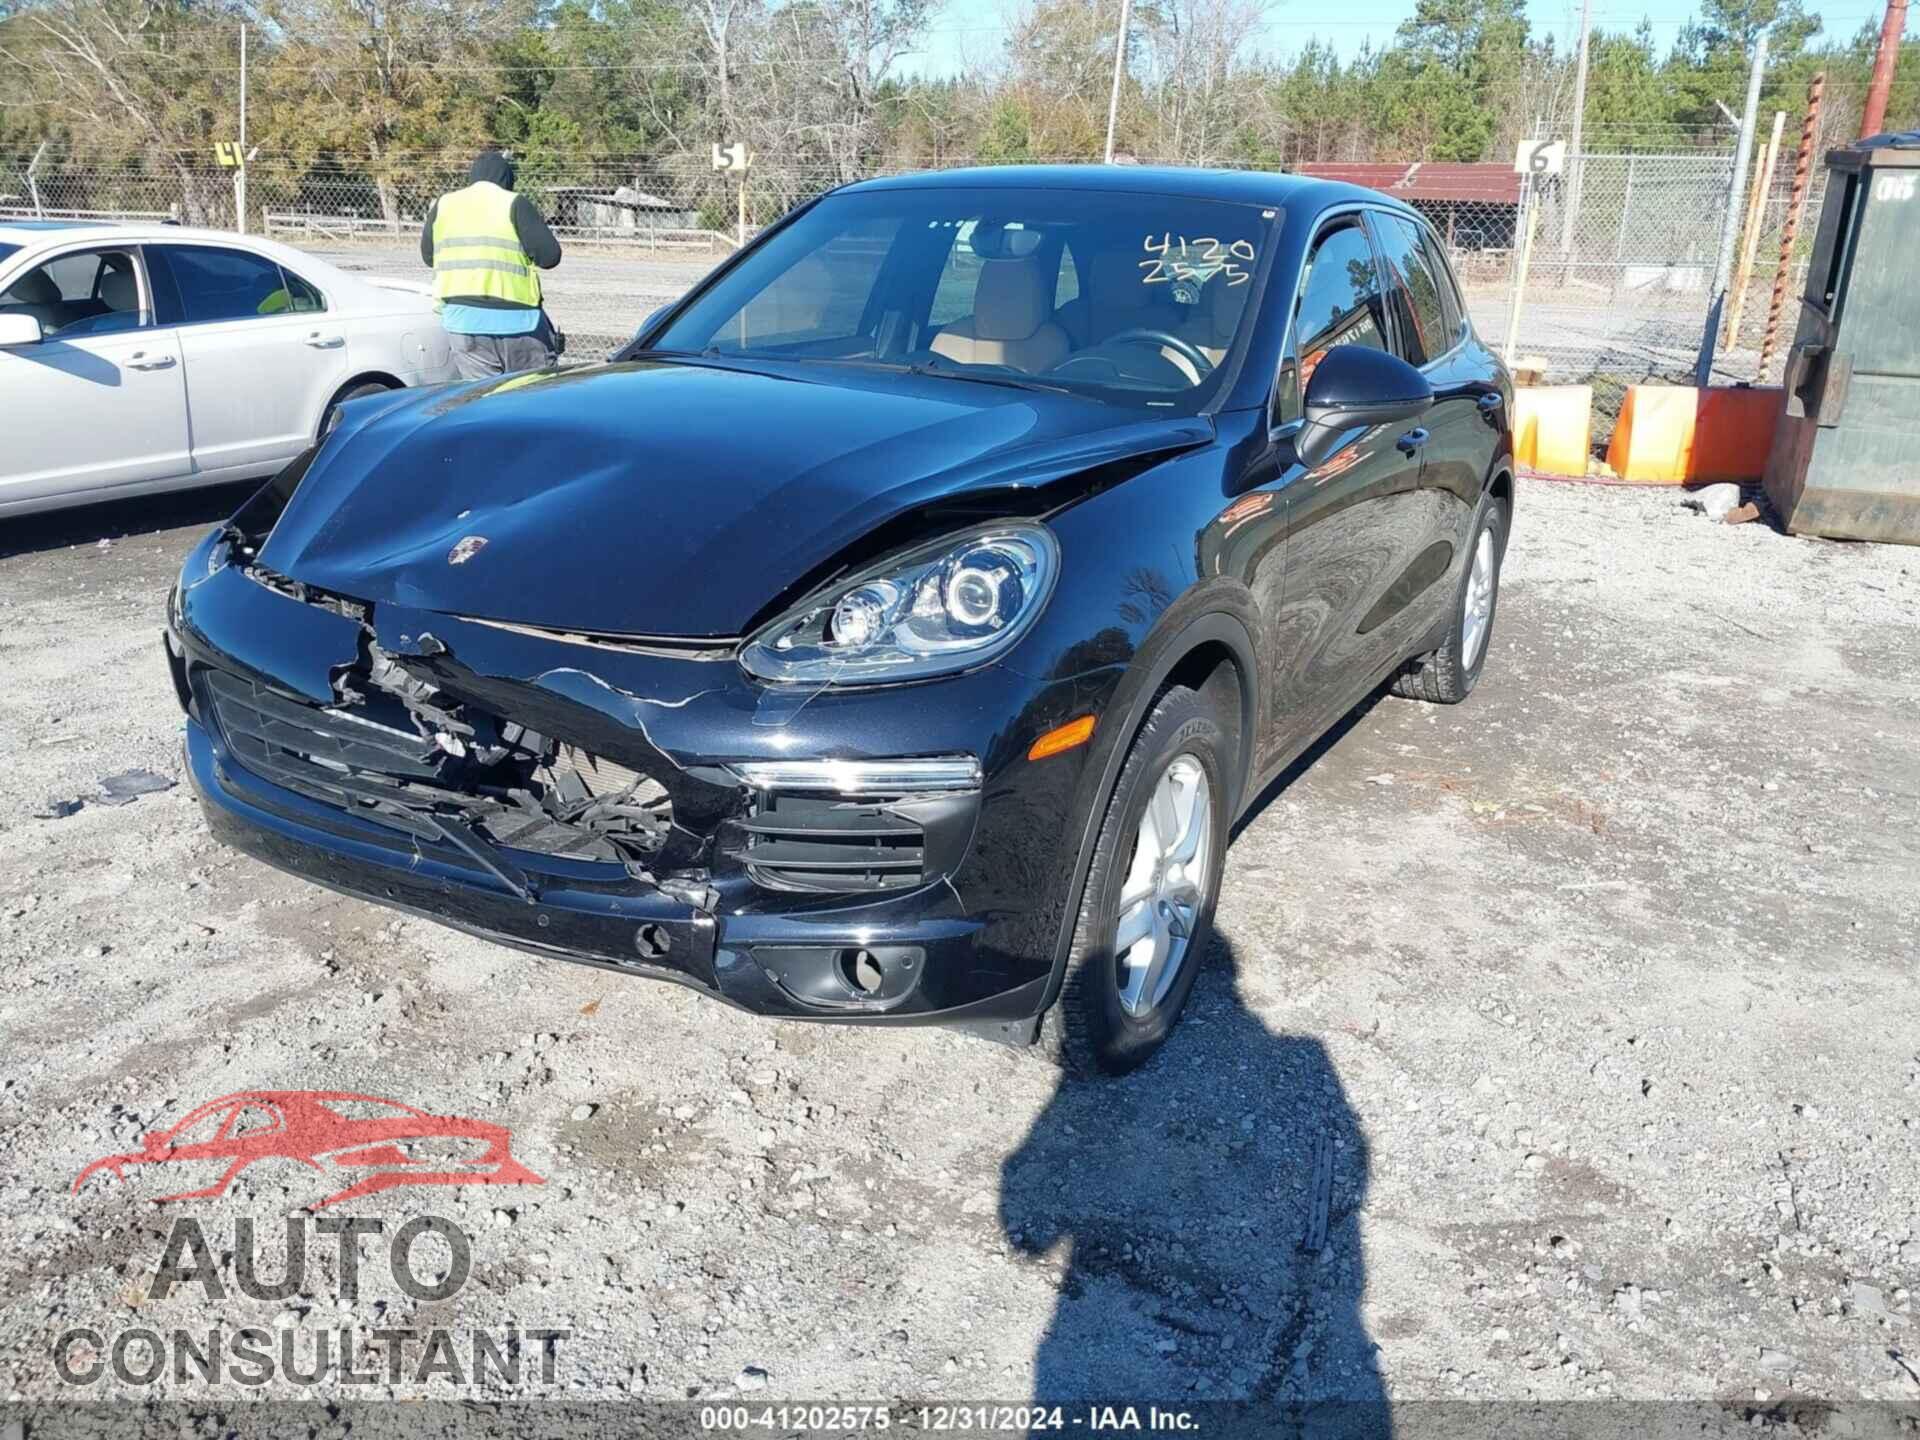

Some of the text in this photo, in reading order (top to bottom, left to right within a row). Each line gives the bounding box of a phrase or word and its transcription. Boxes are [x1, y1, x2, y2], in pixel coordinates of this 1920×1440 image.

[221, 141, 237, 166] 4
[717, 142, 734, 169] 5
[1529, 139, 1555, 172] 6
[1144, 232, 1254, 260] 4120
[1138, 259, 1250, 286] 2575
